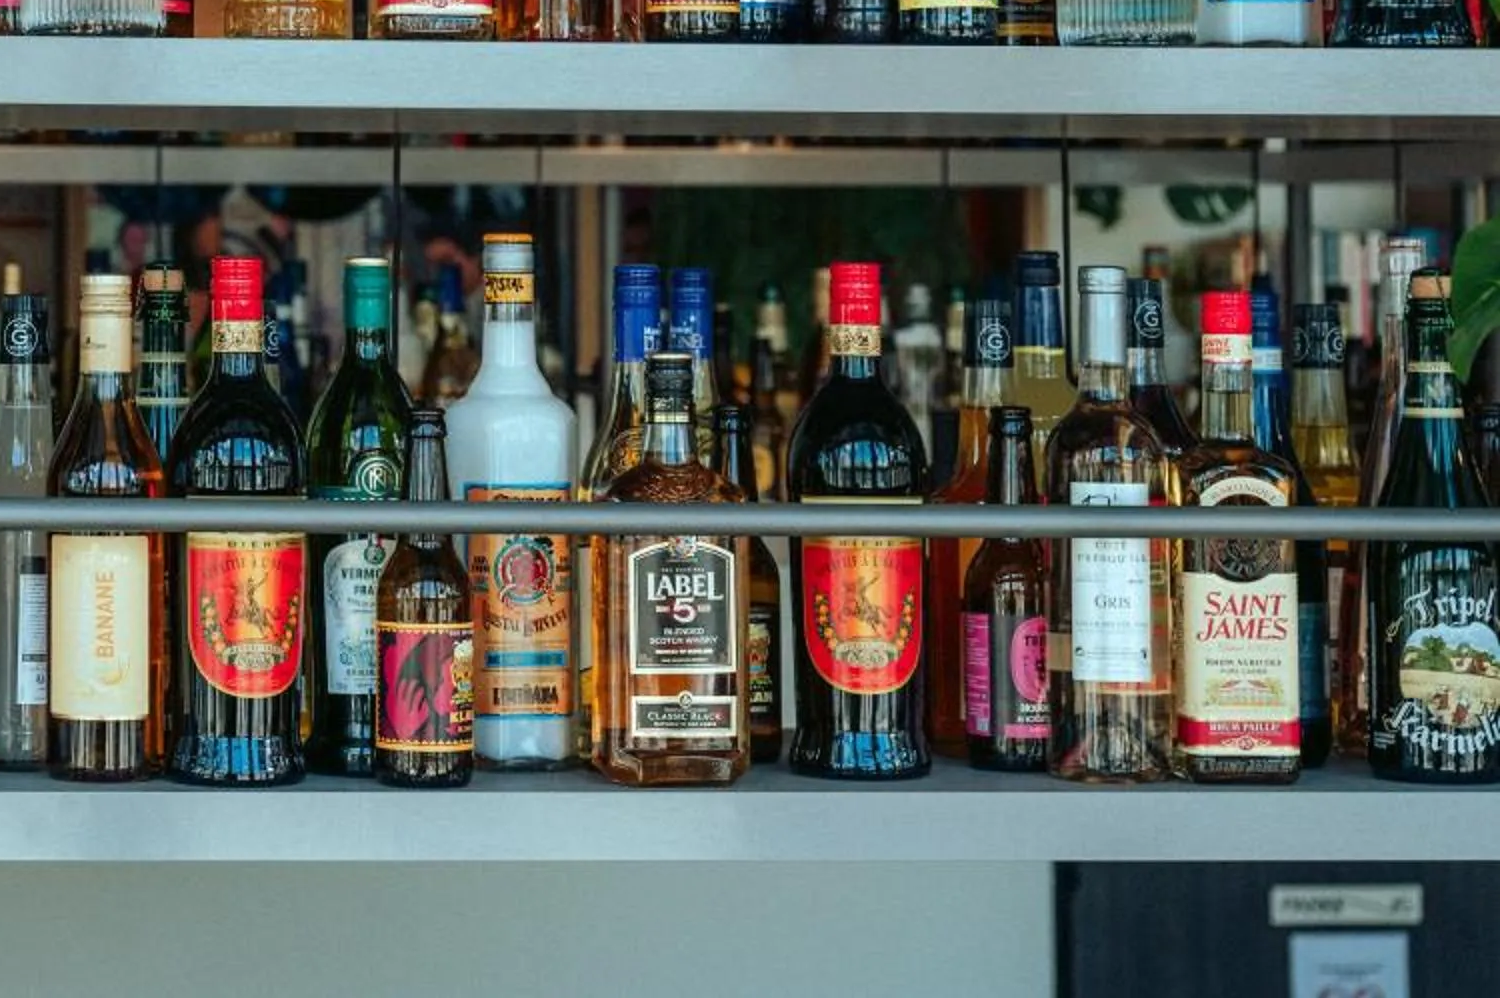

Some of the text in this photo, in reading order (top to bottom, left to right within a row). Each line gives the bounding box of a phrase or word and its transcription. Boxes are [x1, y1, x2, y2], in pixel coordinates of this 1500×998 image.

[341, 567, 381, 579] VERM
[647, 571, 725, 601] LABEL
[96, 571, 115, 658] BANANE
[673, 597, 697, 624] 5
[1203, 591, 1288, 617] SAINT
[1404, 586, 1497, 625] Tripel
[1196, 617, 1289, 642] JAMES
[1384, 699, 1500, 754] Karmeli
